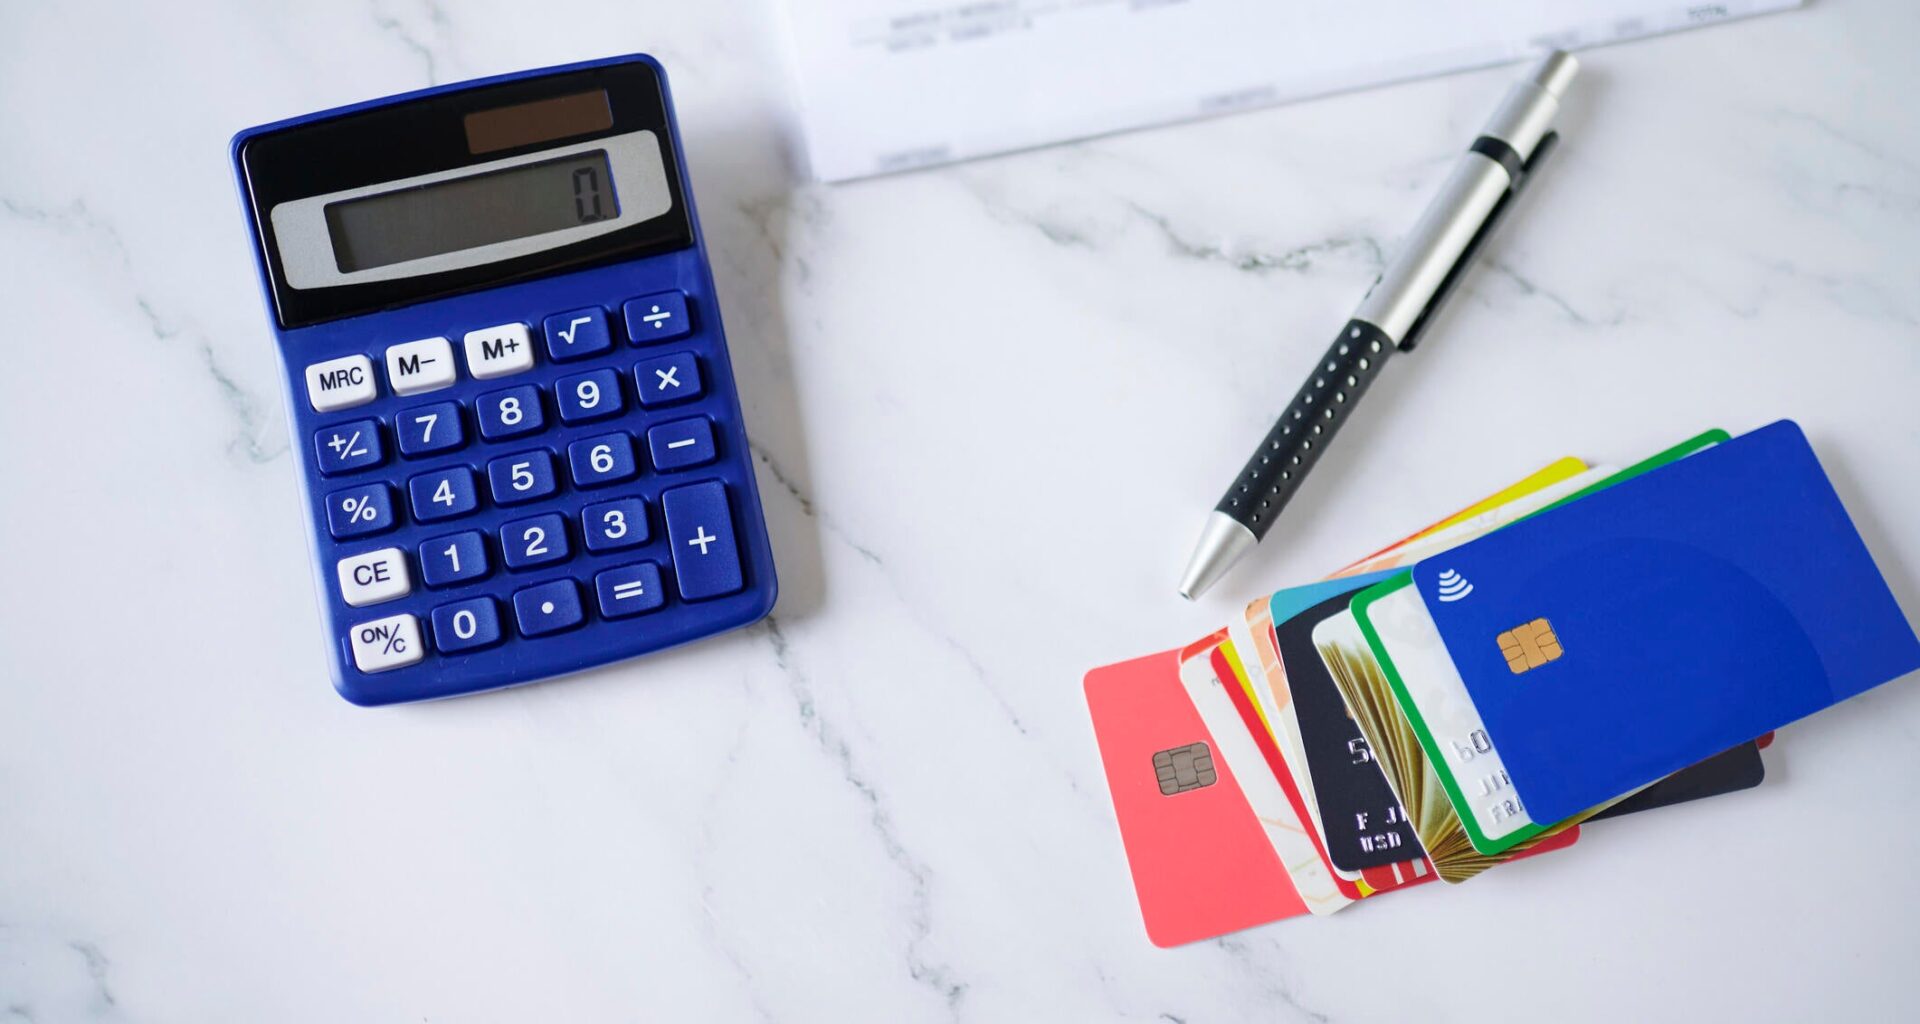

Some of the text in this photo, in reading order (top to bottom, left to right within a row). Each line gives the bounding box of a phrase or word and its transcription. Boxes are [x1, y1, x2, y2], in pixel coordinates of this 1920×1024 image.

[320, 366, 364, 391] MRC
[398, 354, 436, 376] M-
[481, 339, 520, 360] M+
[415, 414, 438, 442] 7
[500, 398, 522, 425] 8
[577, 380, 600, 408] 9
[343, 495, 377, 523] %
[432, 480, 455, 506] 4
[511, 462, 534, 490] 5
[591, 445, 613, 472] 6
[353, 561, 391, 586] CE
[444, 544, 461, 572] 1
[524, 527, 548, 556] 2
[604, 510, 627, 538] 3
[453, 610, 476, 639] 0
[1356, 812, 1368, 831] F
